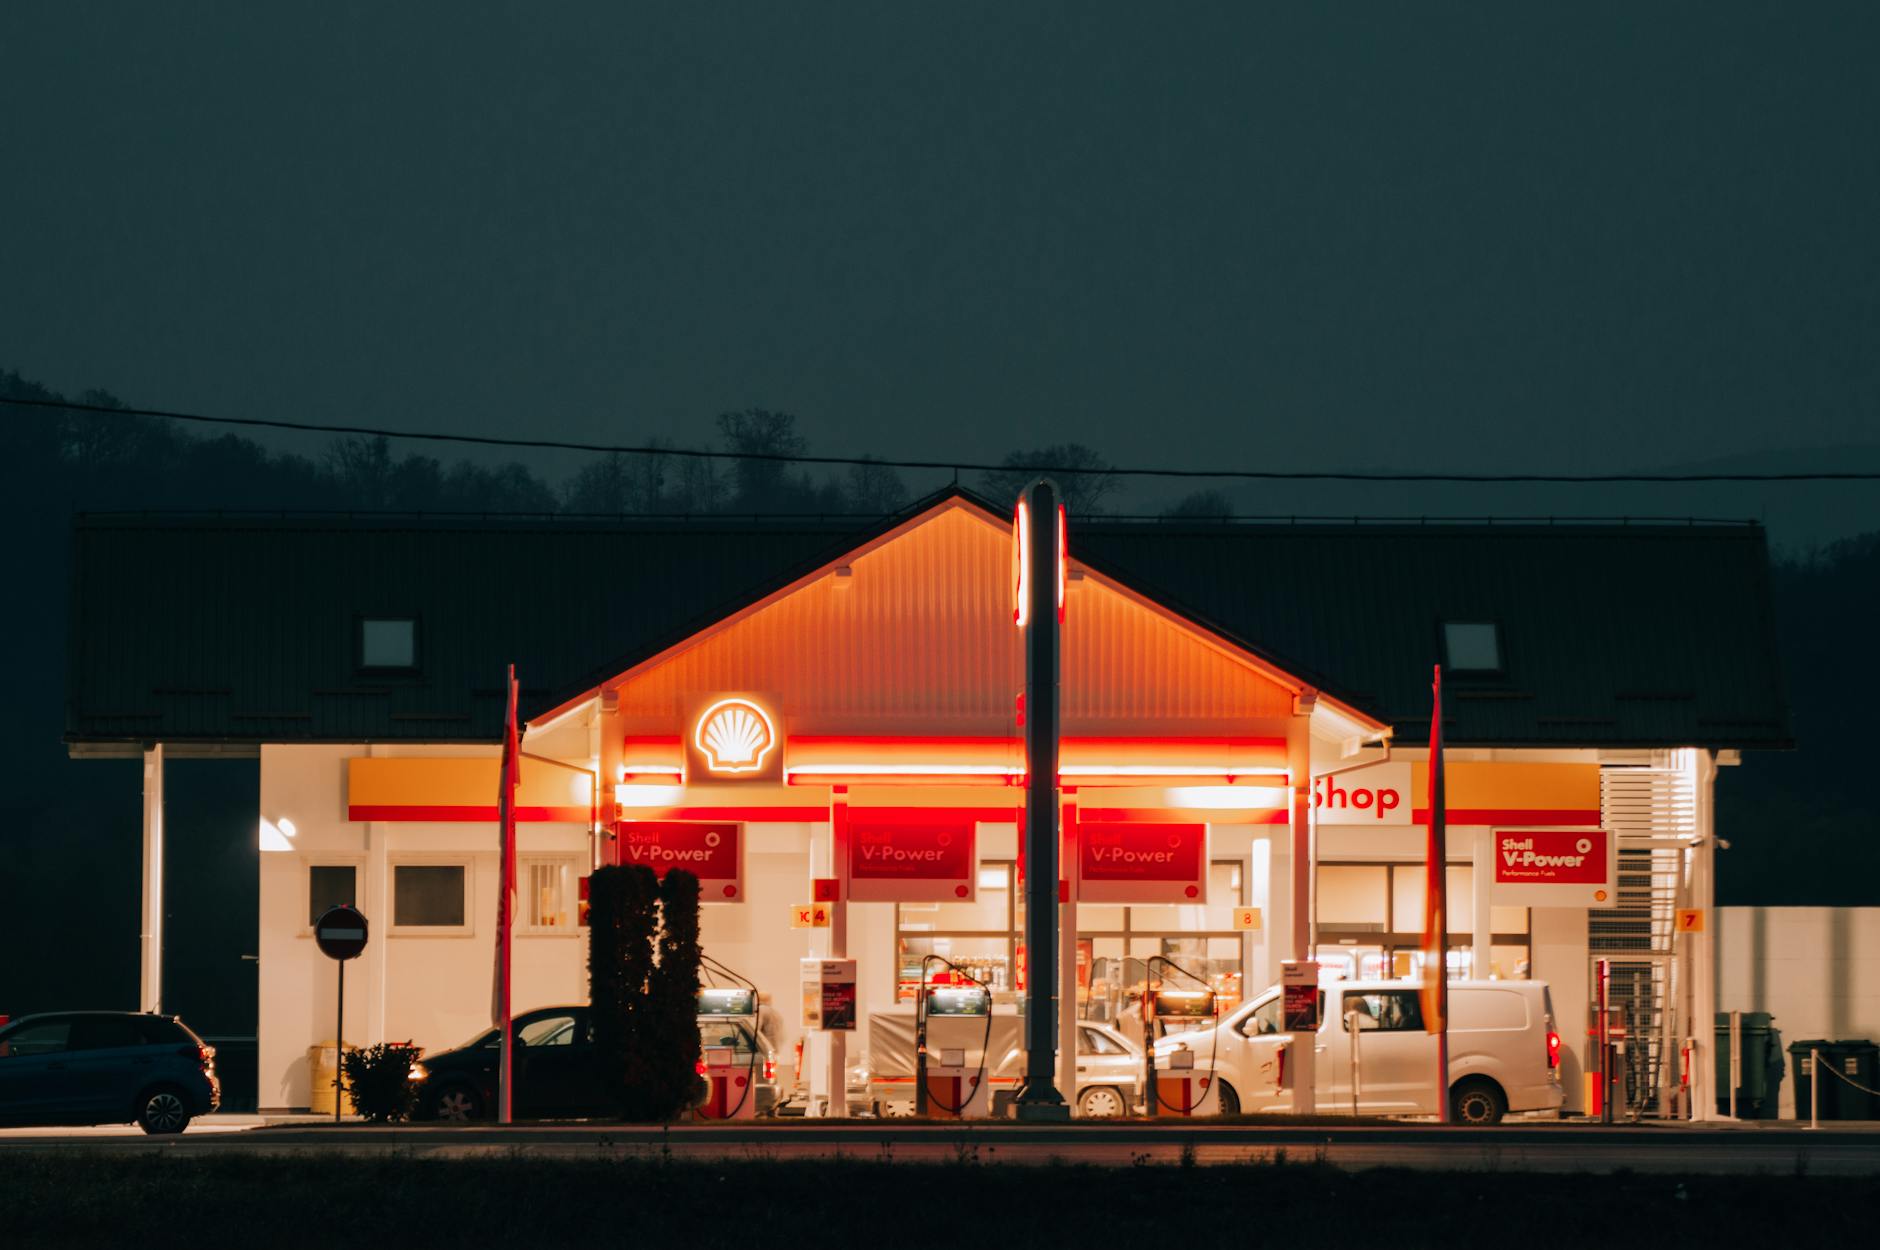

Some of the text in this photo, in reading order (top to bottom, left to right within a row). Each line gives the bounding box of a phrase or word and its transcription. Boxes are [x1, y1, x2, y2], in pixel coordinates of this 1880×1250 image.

[629, 832, 659, 843] Shell
[1502, 838, 1533, 850] Shell
[629, 845, 713, 861] V-Power
[862, 845, 944, 861] V-Power
[1092, 847, 1174, 863] V-Power
[1502, 851, 1585, 867] V-Power
[814, 910, 825, 921] 4
[1243, 913, 1252, 924] 8
[1685, 914, 1696, 927] 7
